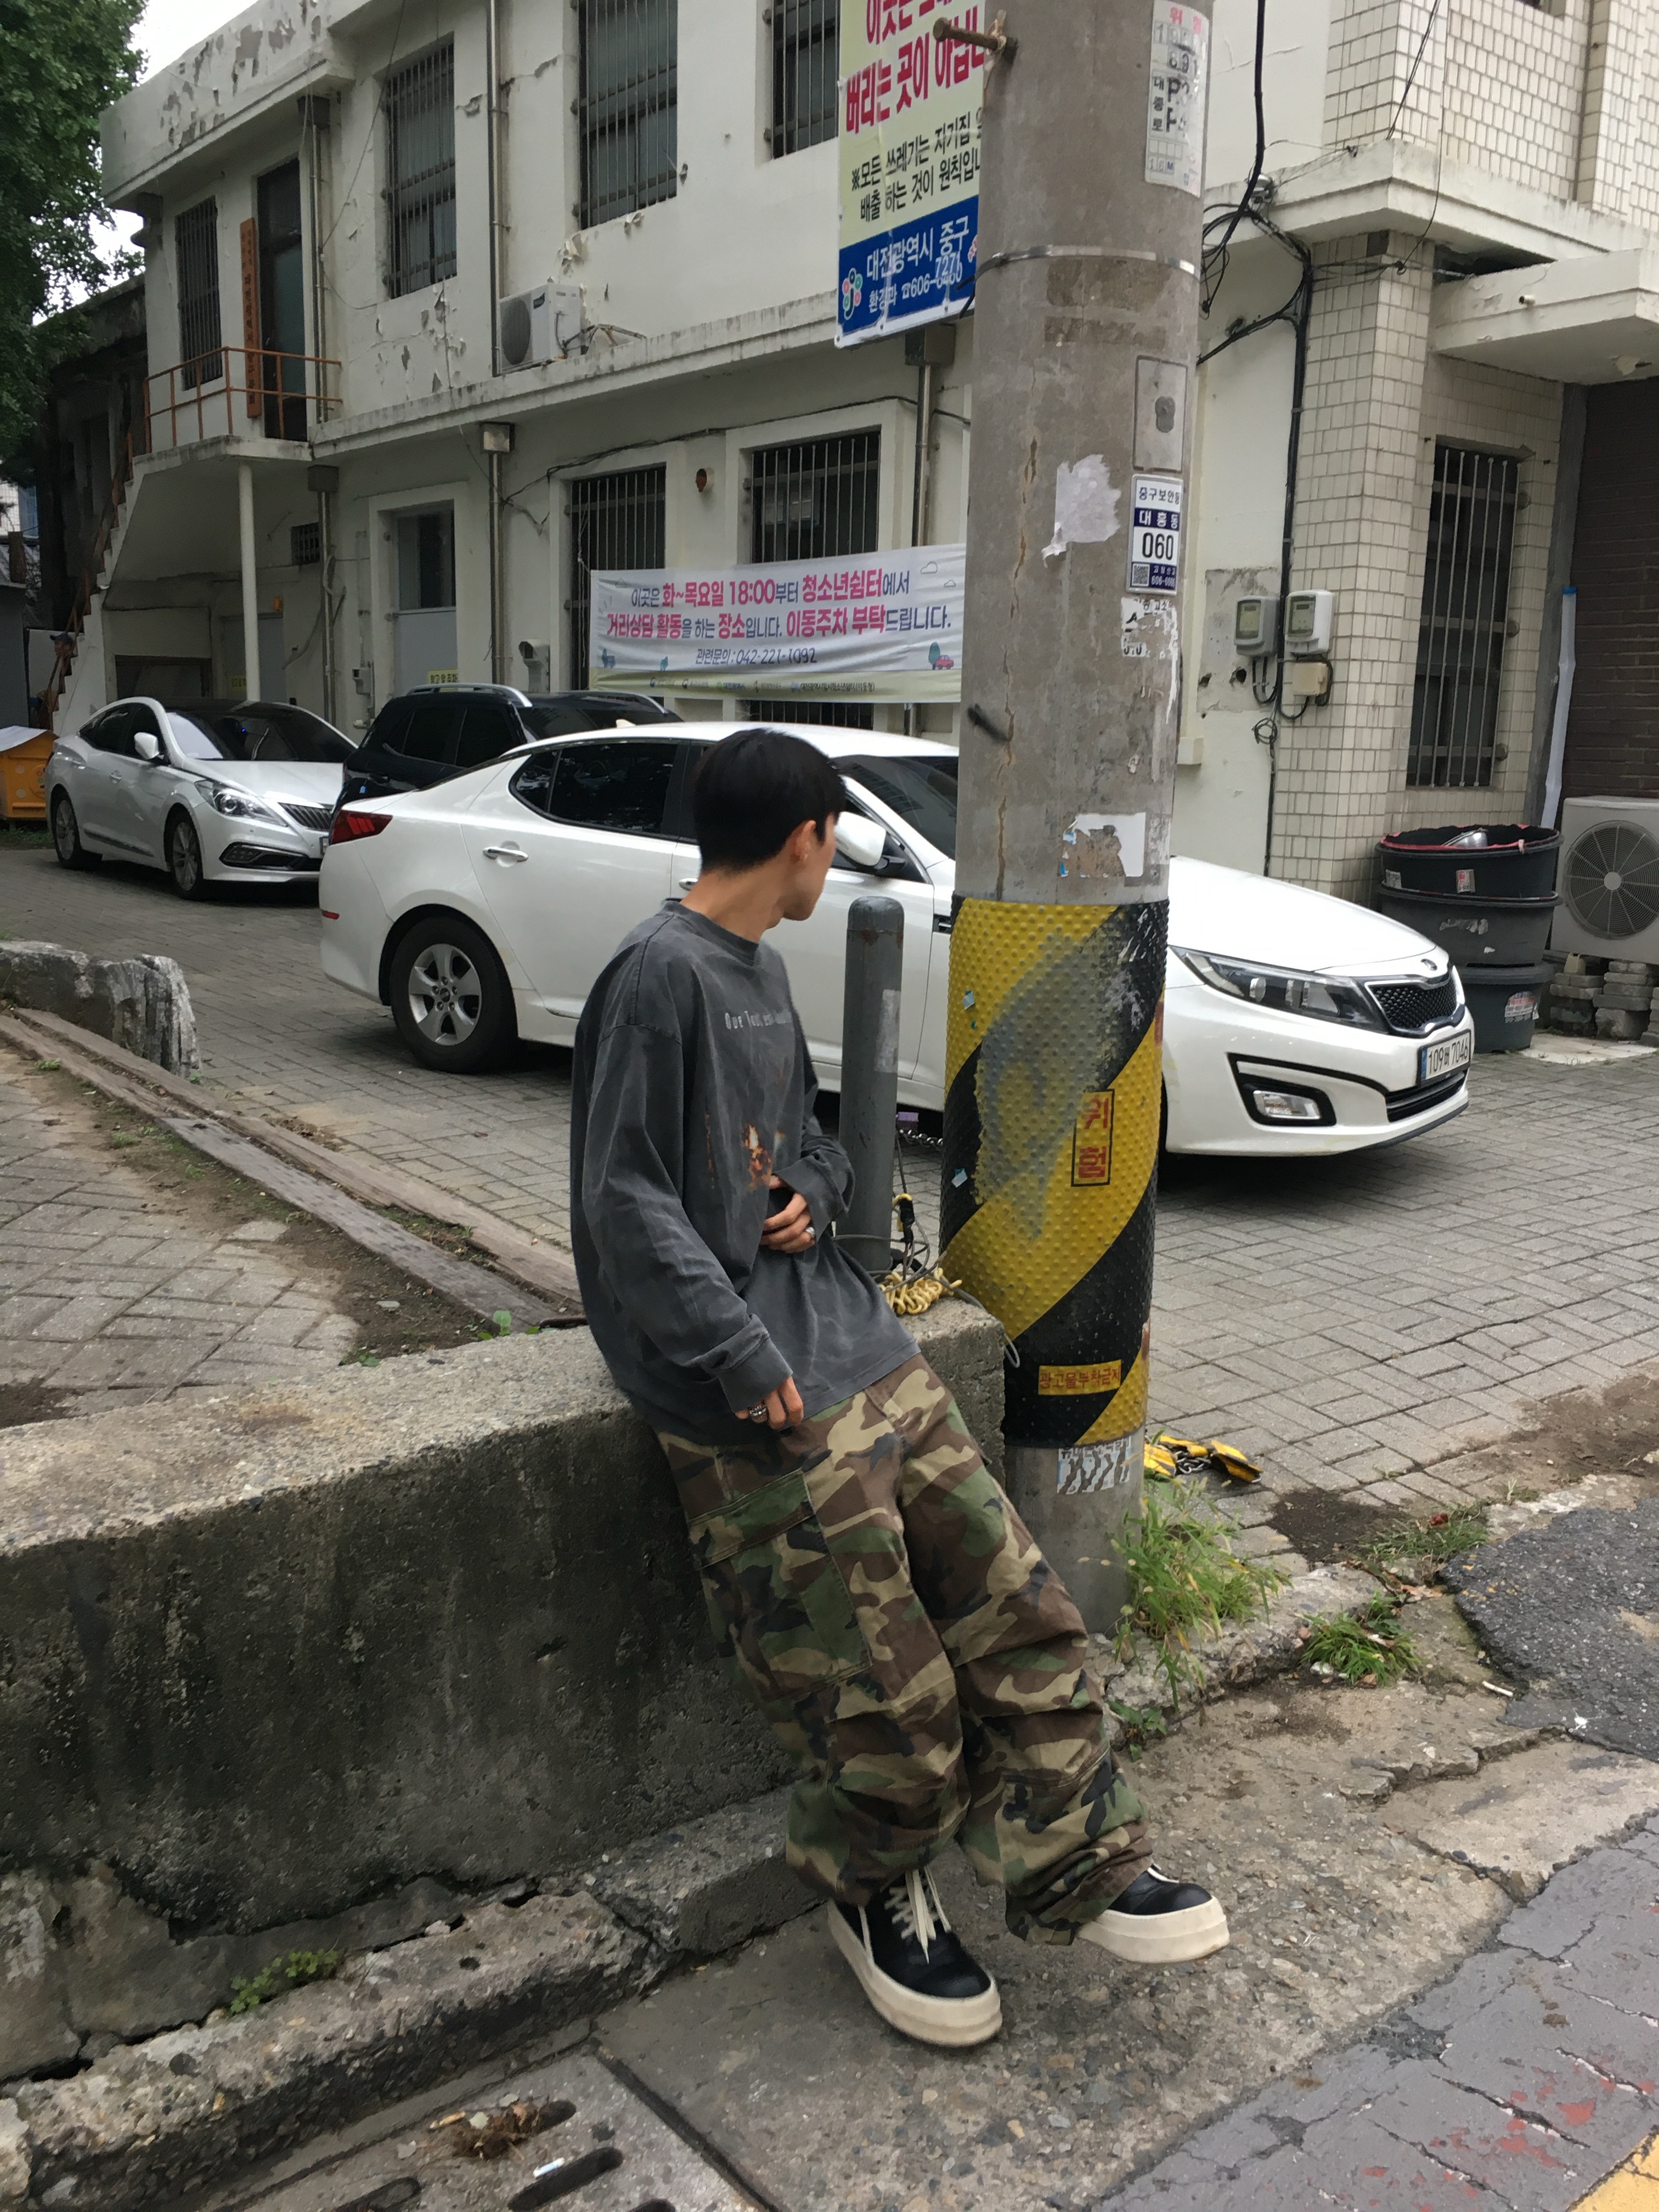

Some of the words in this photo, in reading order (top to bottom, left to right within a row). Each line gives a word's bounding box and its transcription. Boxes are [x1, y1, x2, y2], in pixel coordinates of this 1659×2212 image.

[847, 59, 891, 134] 버리는
[896, 32, 929, 114] 곳이
[885, 134, 930, 176] 쓰레기는
[934, 111, 970, 154] 자기집
[861, 189, 881, 222] 배출
[885, 180, 907, 212] 하는
[912, 165, 934, 204] 것이
[867, 227, 933, 281] 대전광역시
[940, 216, 969, 256] 중구
[869, 283, 898, 313] 환경과
[1139, 510, 1178, 529] 대흥동
[1142, 532, 1173, 560] 060
[631, 588, 660, 607] 이곳은
[662, 580, 724, 608] 화~목요일
[729, 579, 798, 605] 18:00부터
[802, 568, 910, 603] 청소년쉼터에서
[607, 613, 654, 639] 거리상담
[657, 613, 692, 639] 활동을
[695, 618, 715, 639] 하는
[719, 613, 782, 639] 장소입니다.
[787, 607, 848, 637] 이동주차
[852, 605, 952, 635] 부탁드립니다.
[1452, 1036, 1469, 1065] 7046
[1079, 1098, 1109, 1178] 위험
[1040, 1365, 1121, 1389] 광고물부착금지
